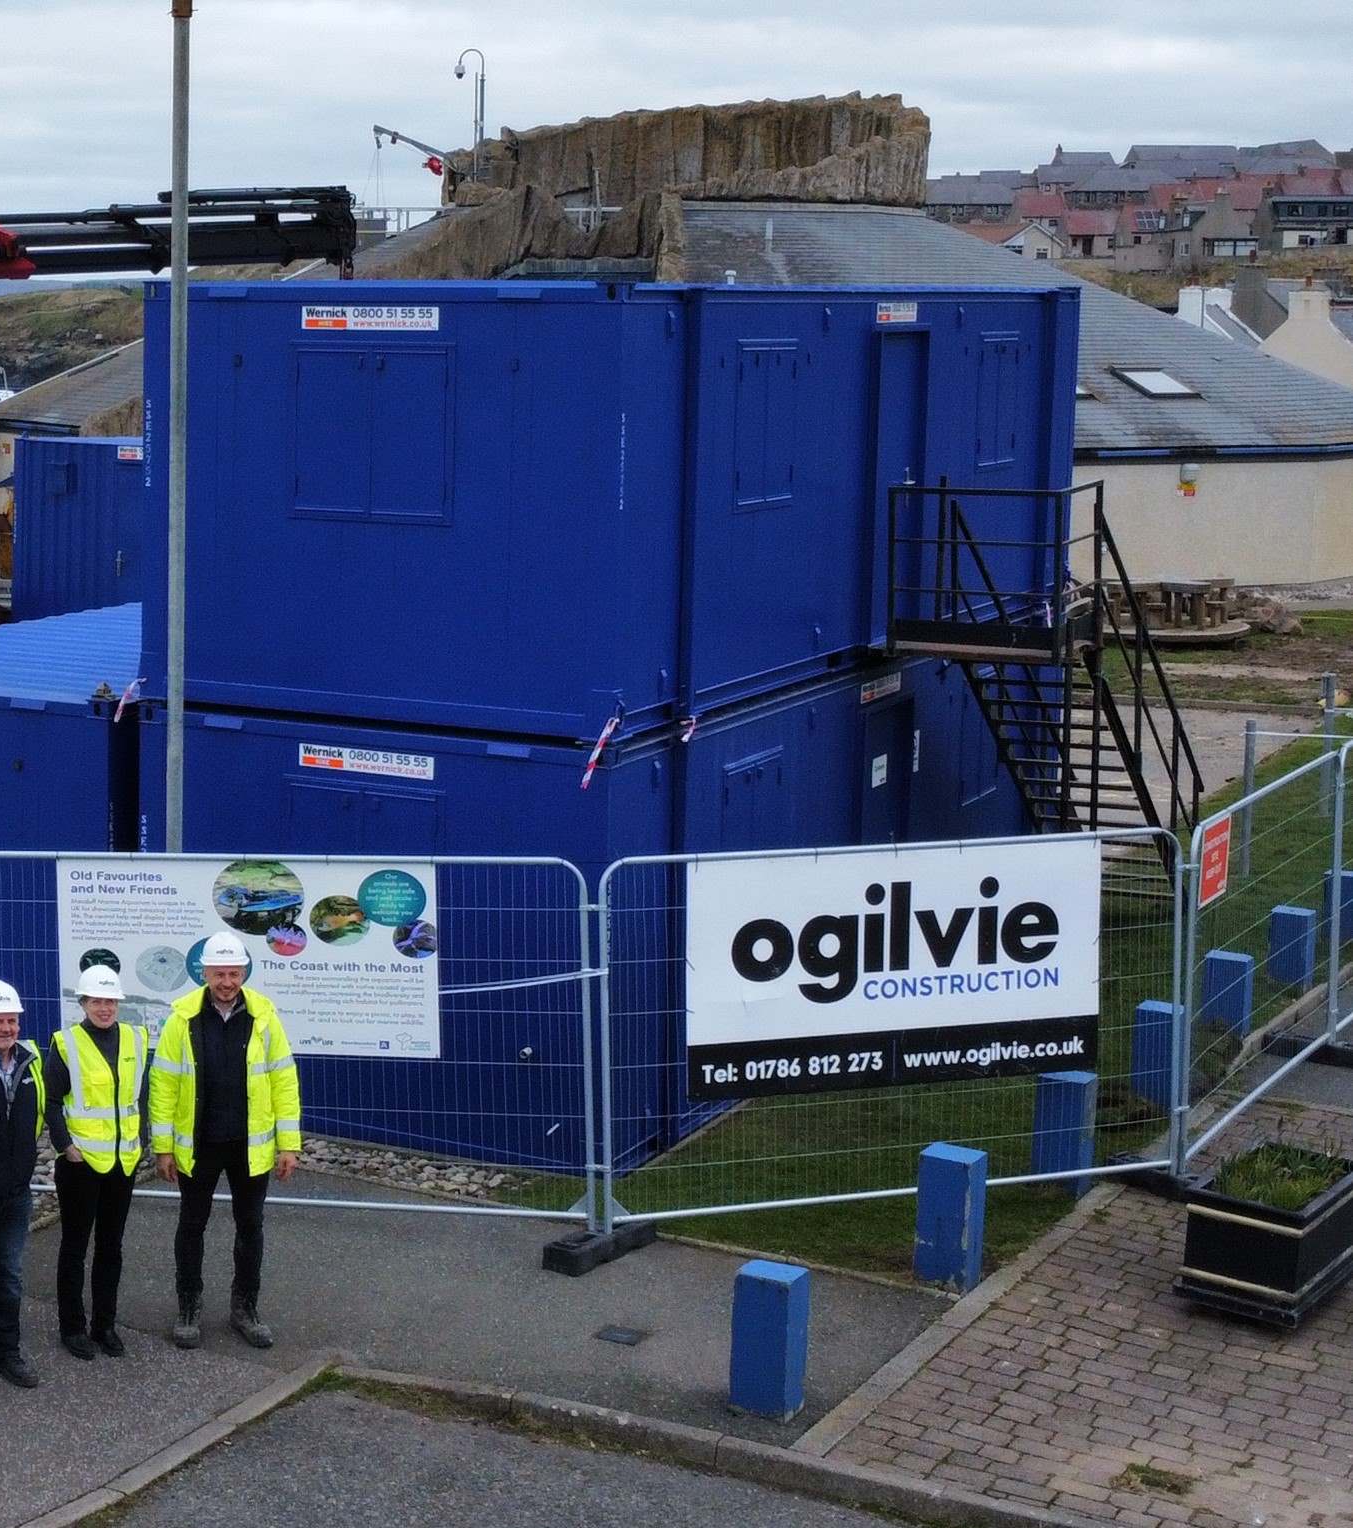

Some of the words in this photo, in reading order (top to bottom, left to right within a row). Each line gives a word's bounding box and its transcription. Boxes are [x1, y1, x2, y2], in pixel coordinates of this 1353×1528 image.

[305, 308, 347, 318] Wernick
[353, 308, 383, 318] 0800
[386, 308, 397, 318] 51
[401, 308, 415, 318] 55
[418, 308, 432, 318] 55
[303, 745, 343, 758] Wernick
[349, 750, 379, 762] 0800
[382, 754, 394, 763] 51
[396, 755, 410, 766] 55
[413, 757, 428, 768] 55
[70, 871, 92, 880] Old
[97, 871, 162, 881] Favourites
[71, 885, 94, 893] and
[98, 885, 125, 894] New
[130, 885, 177, 895] Friends
[731, 876, 1059, 1004] ogilvie
[261, 960, 286, 970] The
[290, 961, 328, 971] Coast
[333, 962, 360, 972] with
[364, 963, 386, 972] the
[390, 964, 423, 973] Most
[863, 967, 1059, 1000] CONSTRUCTION
[701, 1064, 738, 1084] Tel:
[745, 1059, 801, 1080] 01786
[809, 1055, 840, 1075] 812
[847, 1052, 883, 1072] 273
[903, 1036, 1084, 1068] www.ogilvie.co.uk
